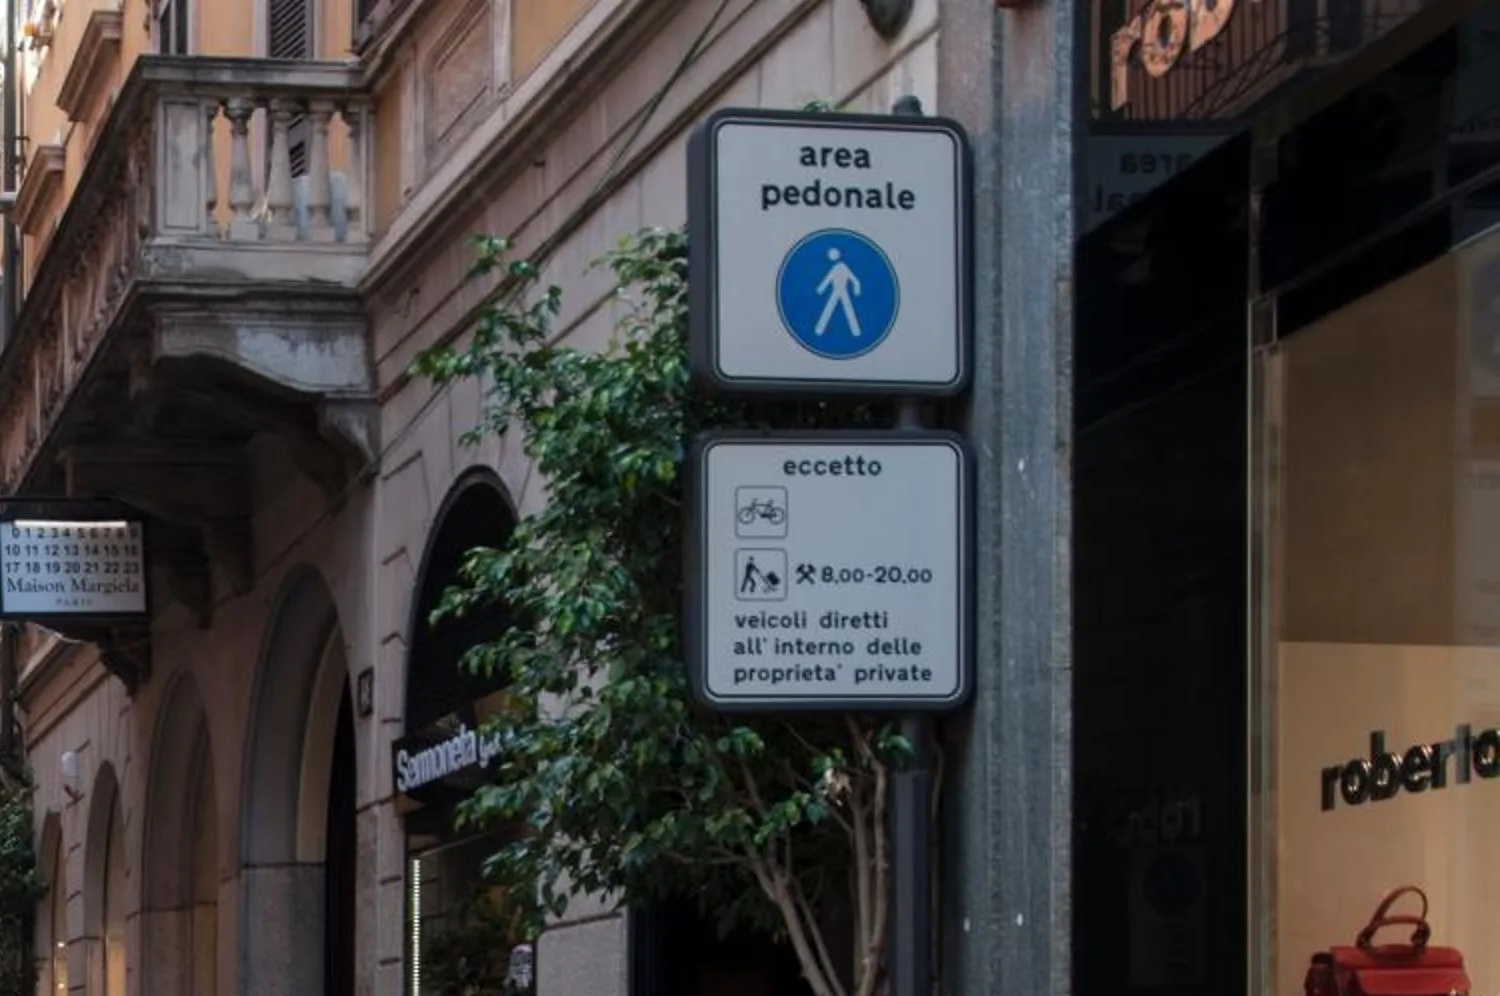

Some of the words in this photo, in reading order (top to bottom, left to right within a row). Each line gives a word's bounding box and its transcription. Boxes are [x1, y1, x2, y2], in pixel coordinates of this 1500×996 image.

[799, 145, 872, 170] area
[761, 180, 916, 211] pedonale
[783, 456, 882, 476] eccetto
[5, 544, 21, 556] 10
[25, 544, 39, 556] 11
[44, 544, 60, 556] 12
[64, 544, 79, 556] 13
[84, 544, 99, 556] 14
[5, 561, 20, 574] 17
[25, 561, 41, 574] 18
[44, 561, 61, 574] 19
[64, 561, 81, 574] 20
[84, 561, 99, 574] 21
[103, 561, 120, 574] 22
[123, 561, 139, 574] 23
[6, 577, 66, 593] Maison
[70, 577, 139, 596] Margiela
[734, 611, 807, 629] veicoli
[819, 611, 889, 629] diretti
[774, 638, 855, 655] interno
[866, 638, 922, 656] delle
[854, 664, 933, 685] private
[396, 723, 477, 793] Sermoneta
